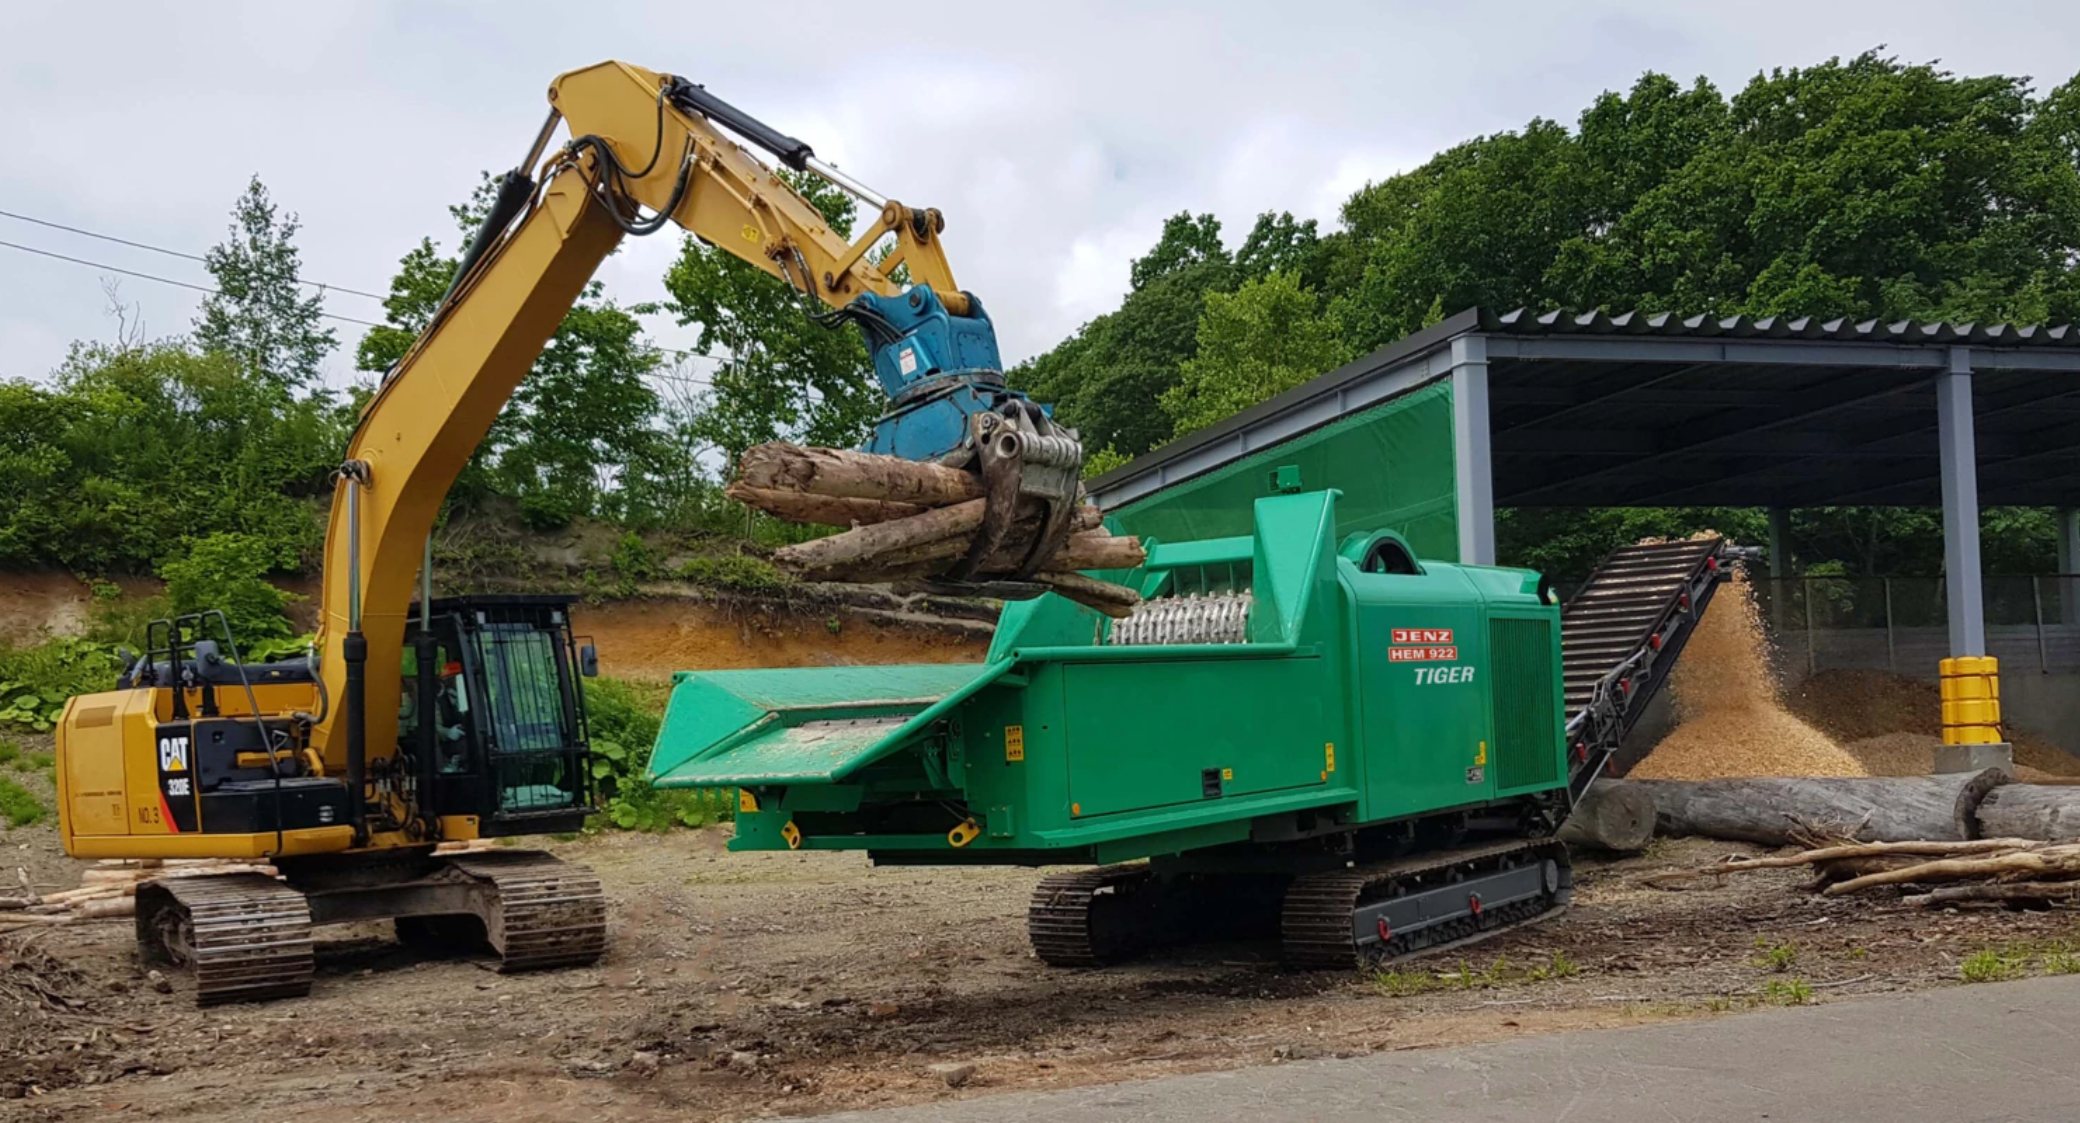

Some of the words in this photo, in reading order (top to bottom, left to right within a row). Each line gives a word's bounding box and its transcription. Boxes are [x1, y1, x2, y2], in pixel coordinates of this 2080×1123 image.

[1395, 631, 1450, 641] JENZ
[1392, 649, 1425, 659] HEM
[1429, 648, 1454, 658] 922
[1414, 666, 1475, 685] TIGER
[160, 737, 188, 771] CAT
[168, 778, 190, 796] 320E
